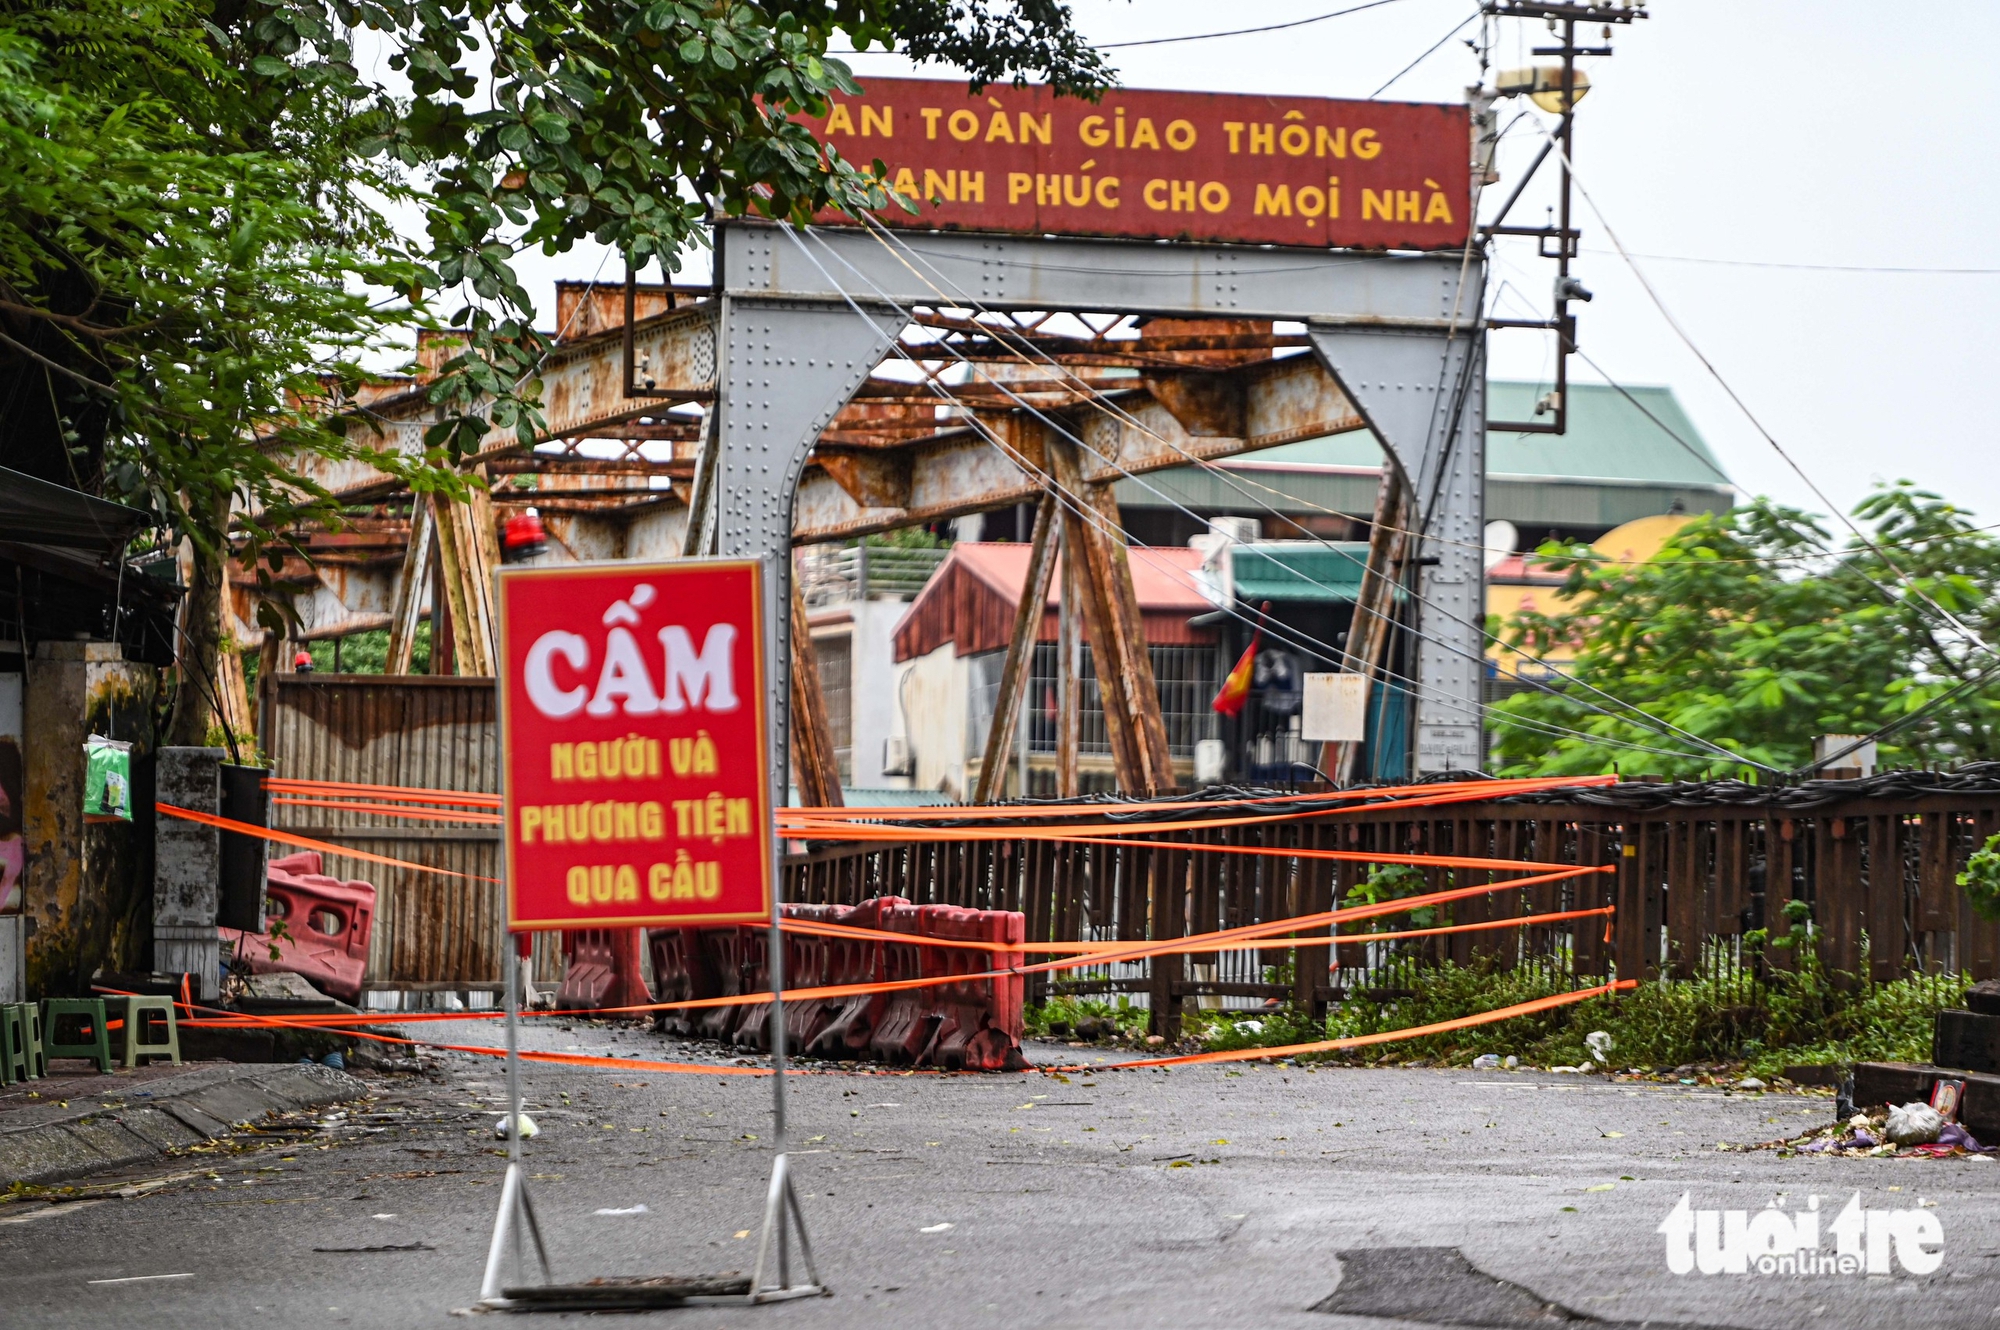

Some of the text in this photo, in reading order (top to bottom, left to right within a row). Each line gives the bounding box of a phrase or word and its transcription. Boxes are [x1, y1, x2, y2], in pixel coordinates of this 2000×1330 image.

[824, 103, 893, 138] AN
[920, 97, 1052, 145] TOÀN
[1223, 109, 1383, 161] THÔNG
[1008, 159, 1121, 210] PHÚC
[1143, 178, 1231, 215] CHO
[1362, 178, 1454, 225] NHÀ
[523, 583, 740, 719] CẤM
[550, 729, 717, 781] NGƯỜI VÀ
[519, 791, 751, 844] PHƯƠNG TIỆN
[566, 848, 722, 907] QUA CẦU
